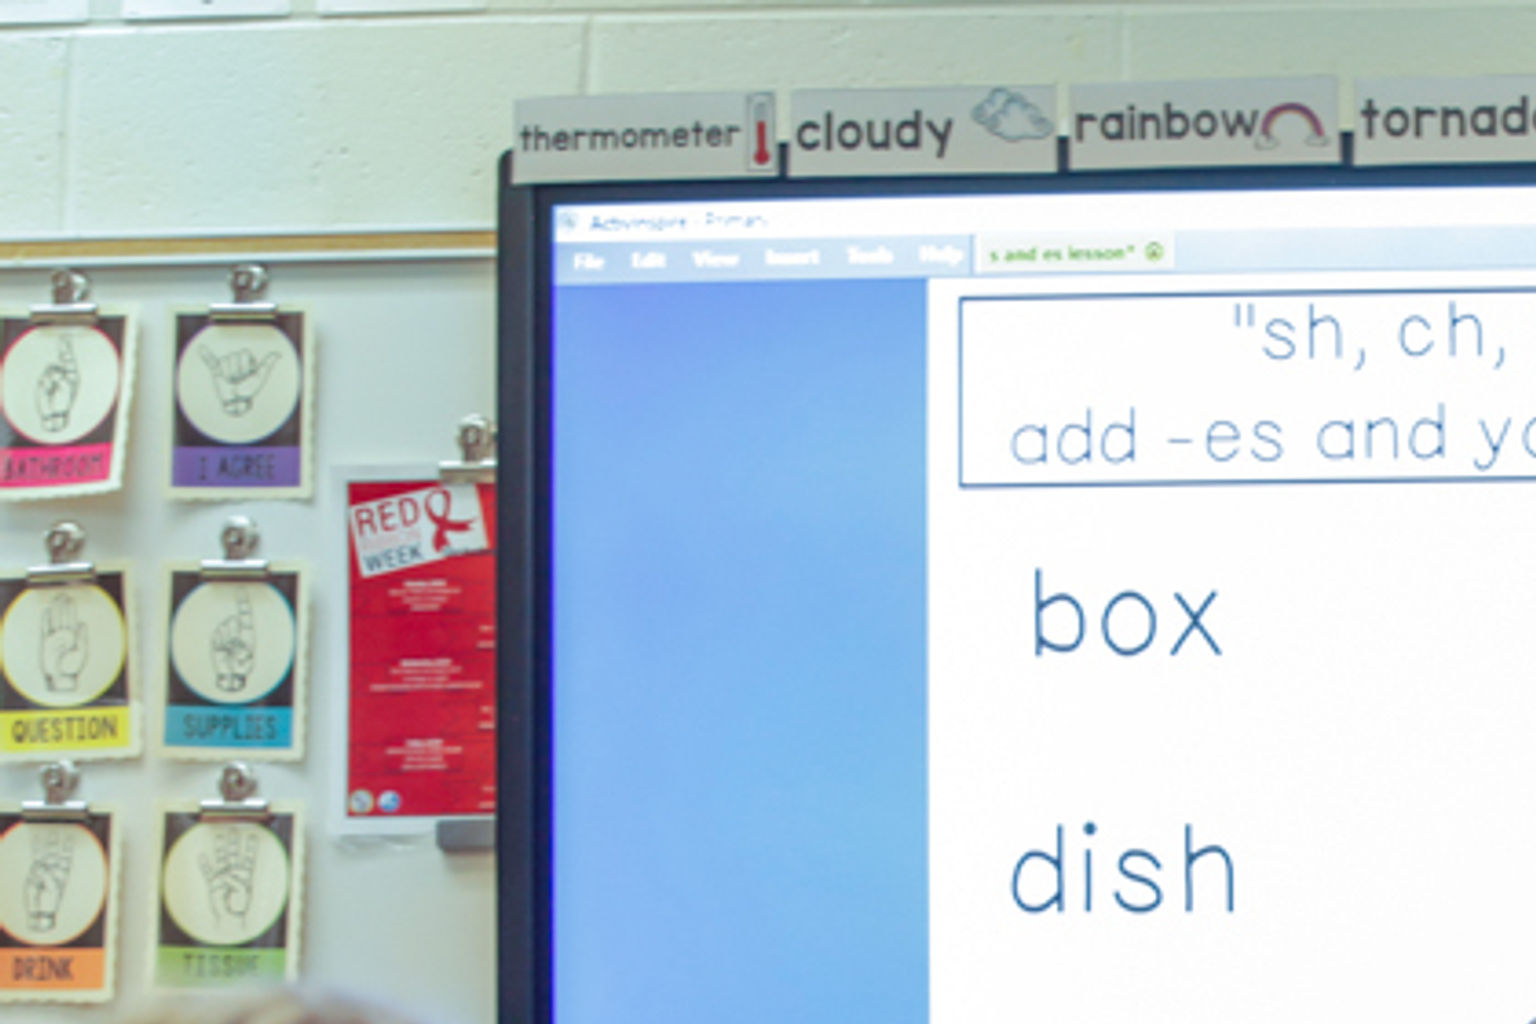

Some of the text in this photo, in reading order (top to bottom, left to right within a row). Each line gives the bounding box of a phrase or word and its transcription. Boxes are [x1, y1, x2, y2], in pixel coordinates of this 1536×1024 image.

[520, 119, 741, 152] thermometer
[796, 109, 954, 158] cloudy
[1075, 102, 1260, 144] rainbow
[574, 252, 605, 269] File
[1004, 246, 1037, 261] and
[1233, 304, 1368, 370] "sh,
[1398, 303, 1507, 368] ch,
[1010, 406, 1137, 465] add
[1165, 418, 1285, 463] -es
[1317, 402, 1447, 460] and
[354, 496, 421, 537] RED
[362, 542, 424, 572] WEEK
[1034, 568, 1222, 657] box
[11, 714, 119, 744] QUESTION
[182, 713, 277, 741] SUPPLIES
[1011, 822, 1235, 914] dish
[12, 955, 75, 982] DRINK
